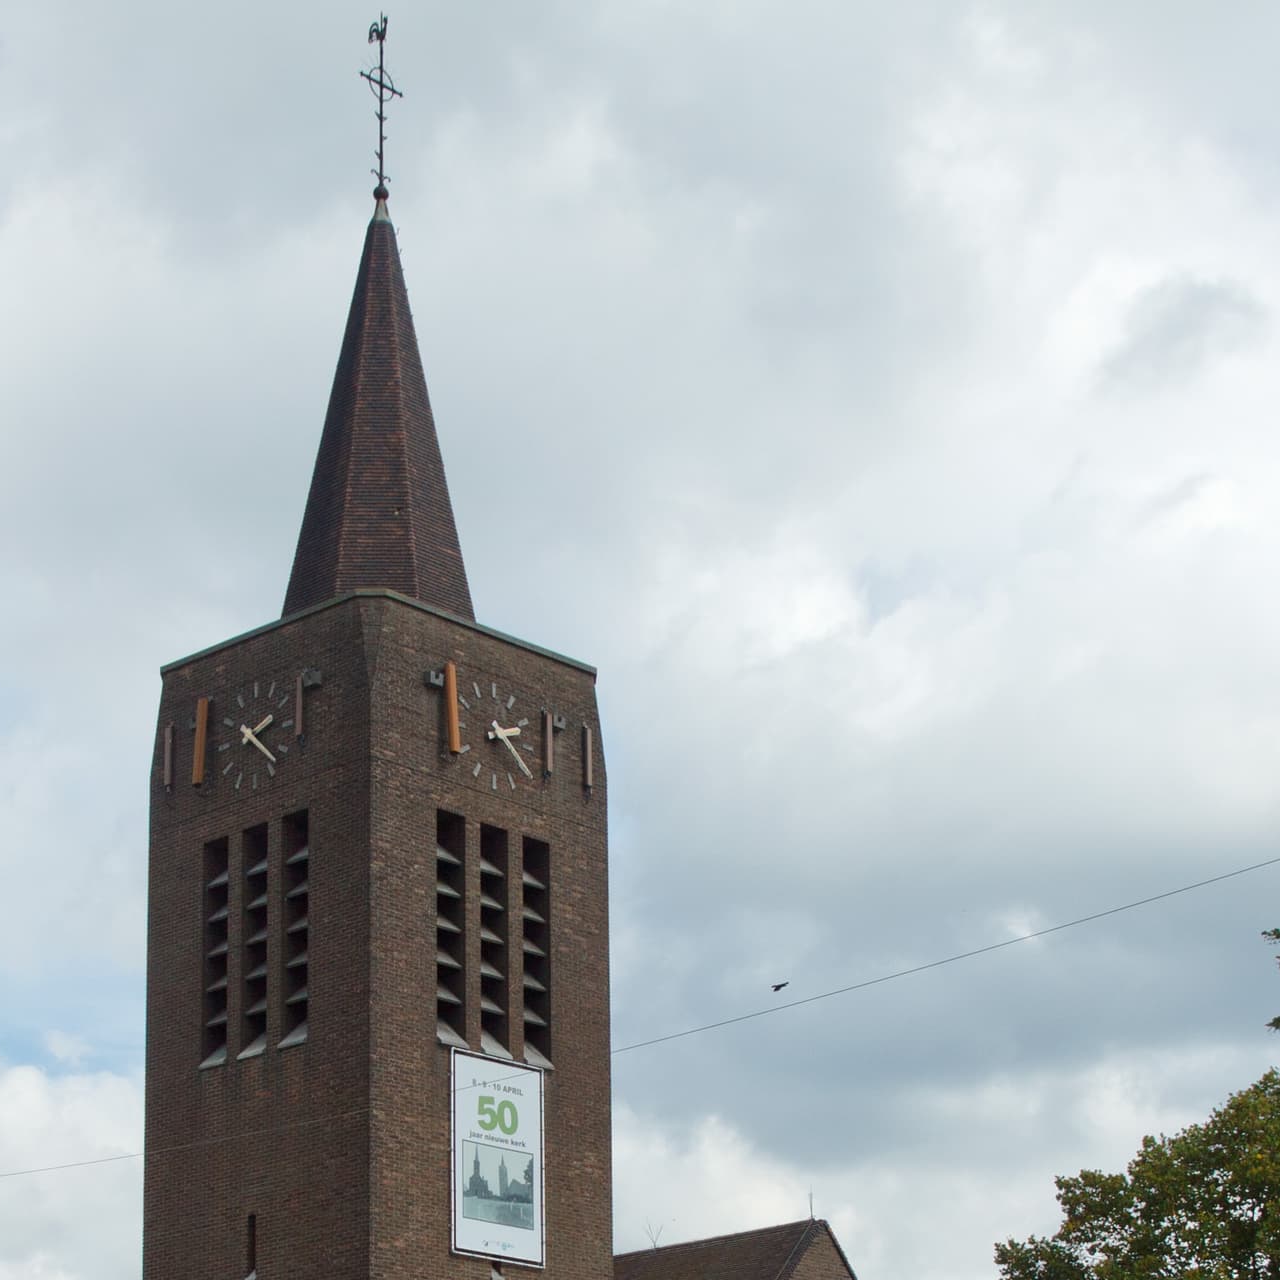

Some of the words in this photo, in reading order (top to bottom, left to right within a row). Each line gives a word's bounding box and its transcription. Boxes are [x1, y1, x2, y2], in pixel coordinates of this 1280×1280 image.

[503, 1085, 524, 1096] APRIL
[477, 1095, 519, 1135] 50
[469, 1130, 483, 1139] jaar
[484, 1134, 509, 1144] nieuwe
[510, 1138, 526, 1147] kerk
